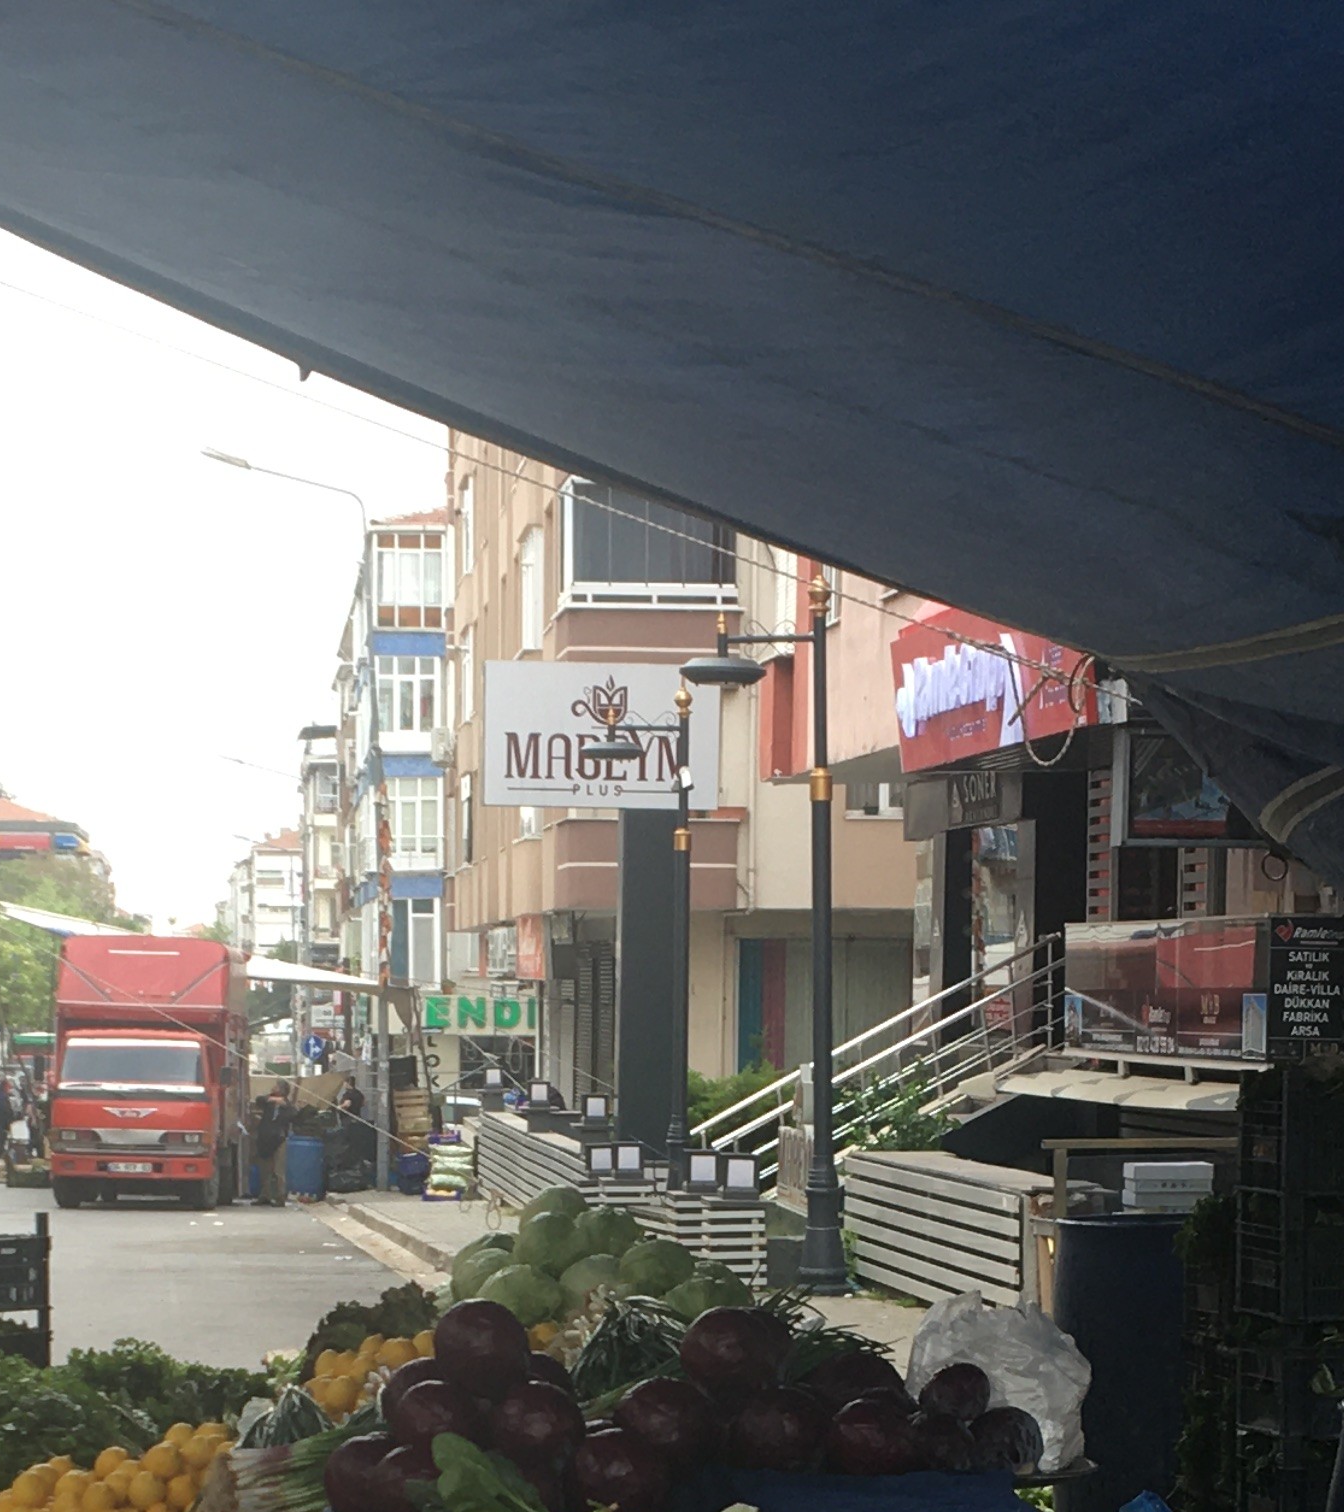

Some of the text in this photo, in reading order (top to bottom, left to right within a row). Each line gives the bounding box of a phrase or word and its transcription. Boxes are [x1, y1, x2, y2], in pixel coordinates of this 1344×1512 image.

[572, 784, 622, 796] PLUS
[1284, 996, 1330, 1008] DÜKKAN
[1282, 1010, 1329, 1022] FABRİKA
[1291, 1025, 1320, 1036] ARSA
